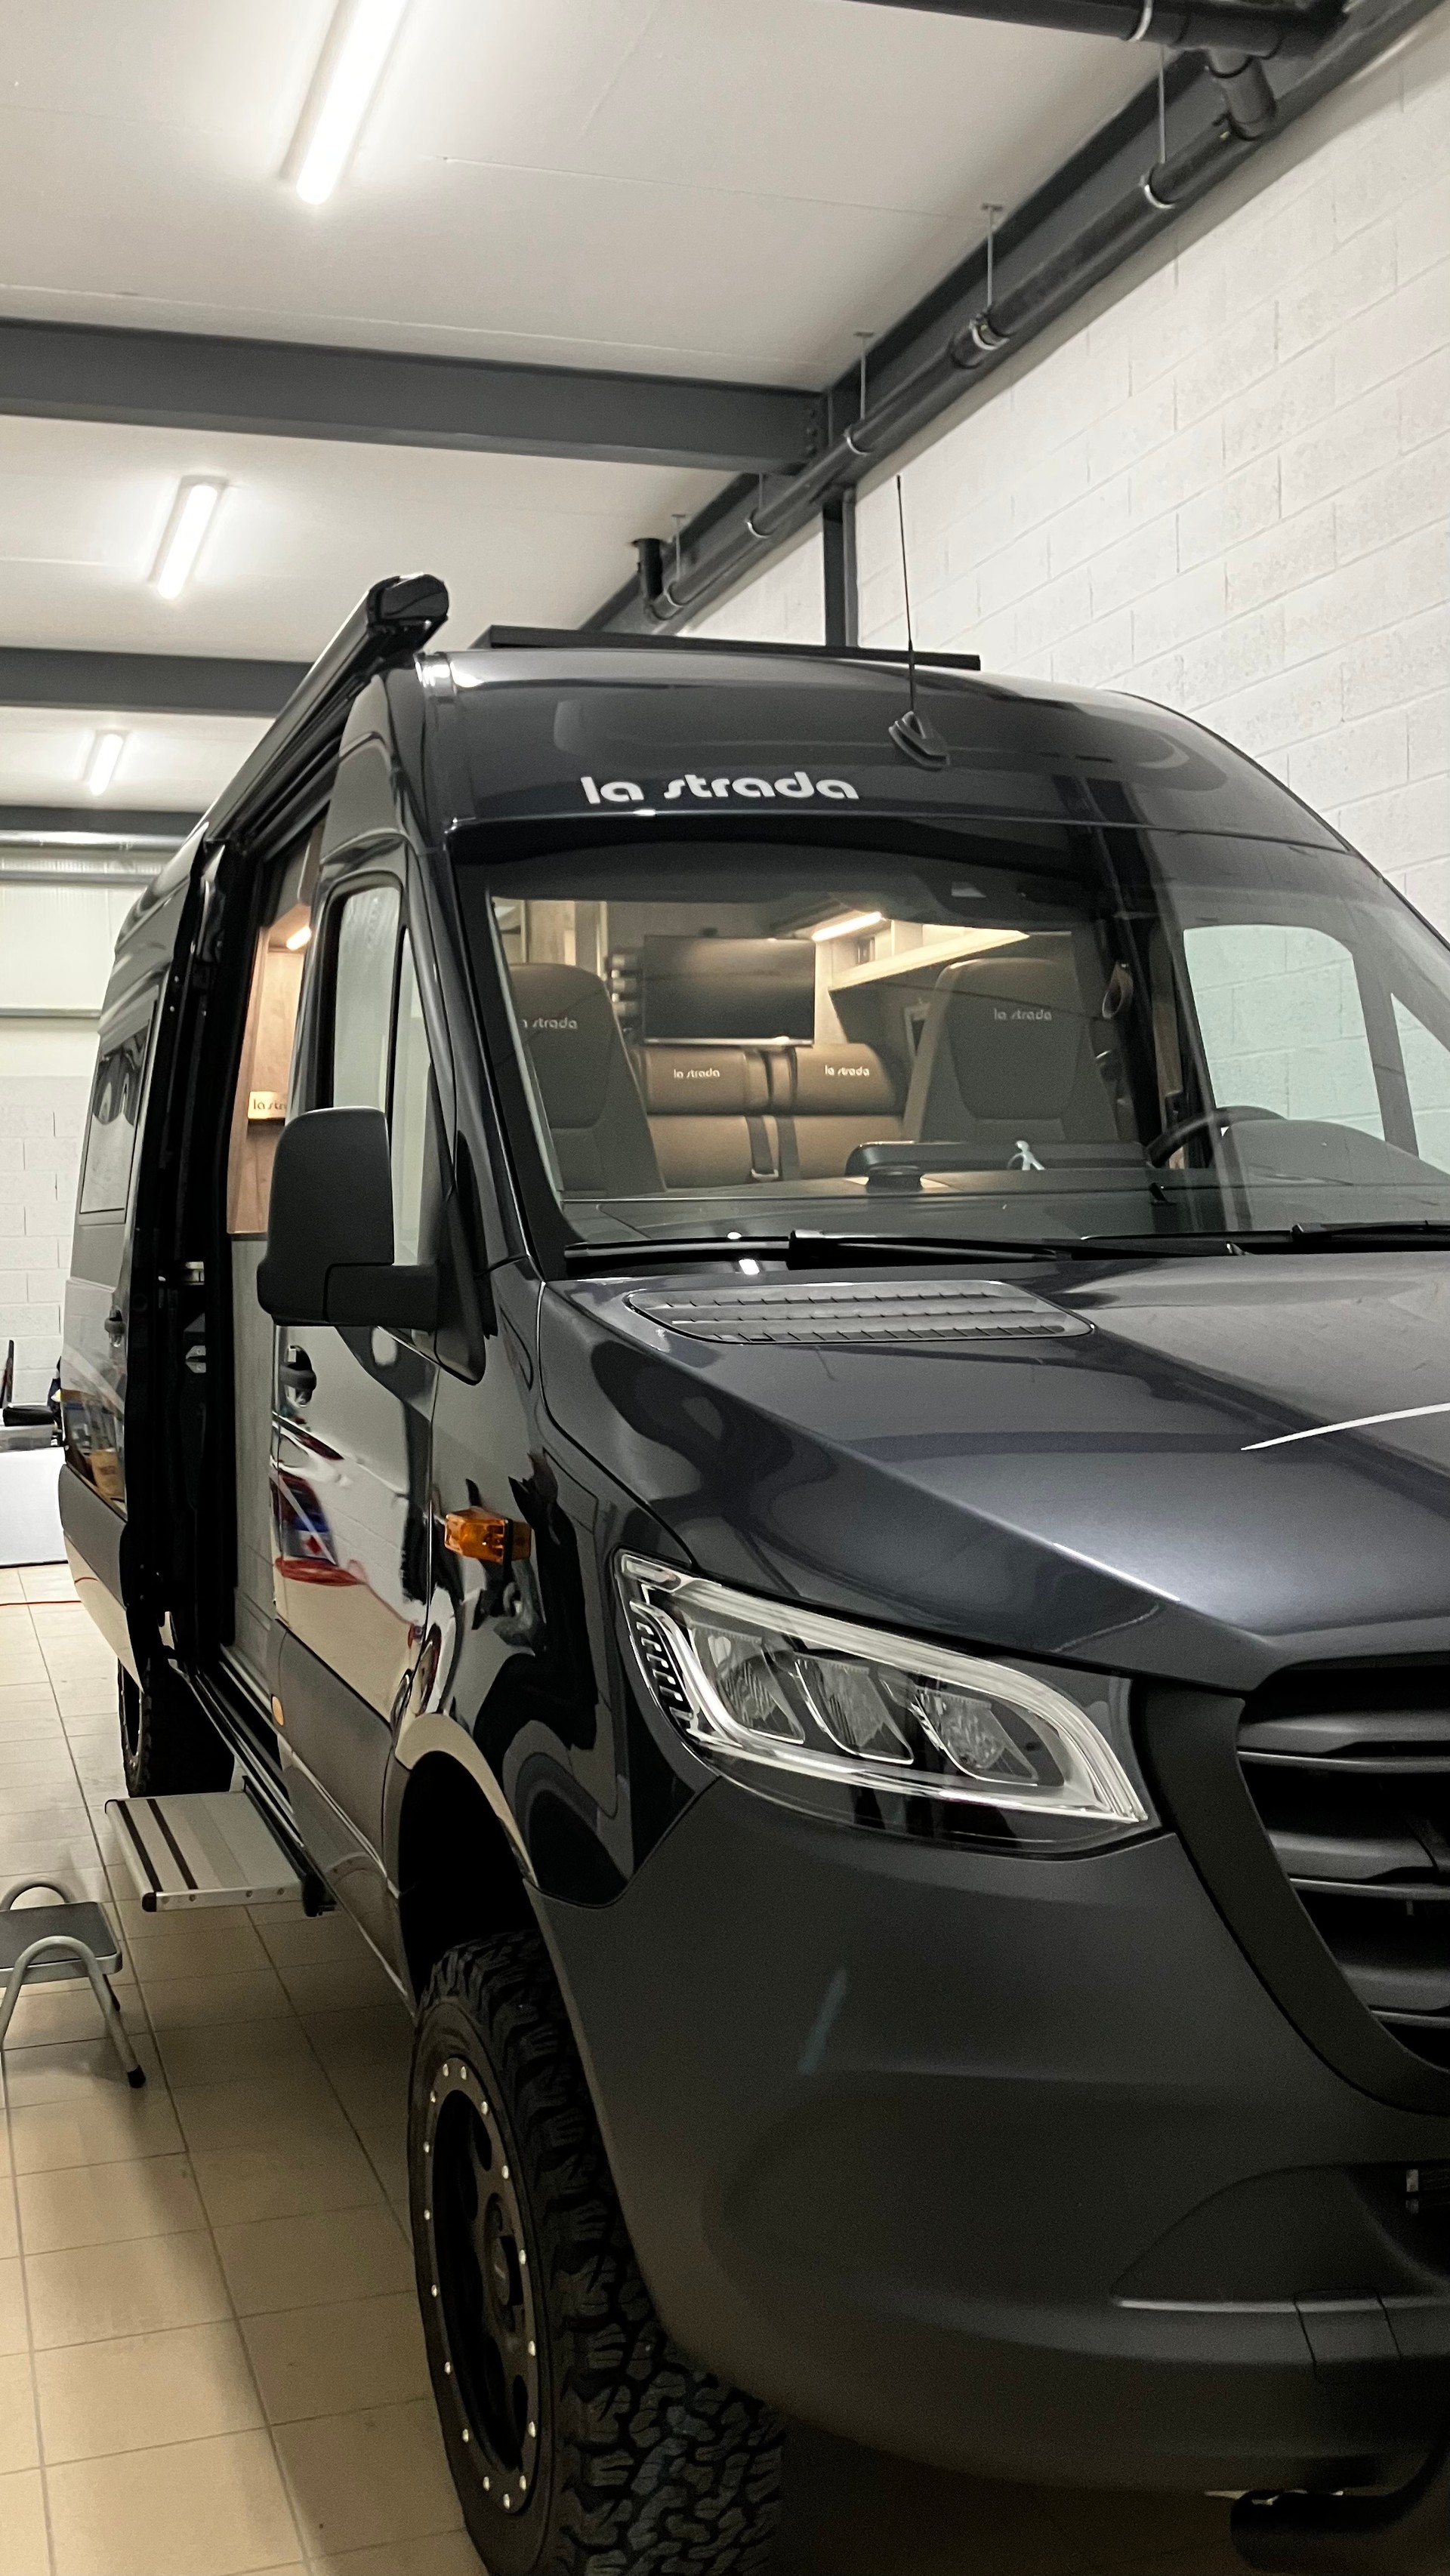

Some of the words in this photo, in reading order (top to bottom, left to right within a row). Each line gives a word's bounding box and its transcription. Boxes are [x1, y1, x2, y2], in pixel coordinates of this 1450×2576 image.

[580, 775, 644, 804] la
[663, 771, 859, 800] strada
[994, 1008, 1007, 1020] la
[1012, 1009, 1052, 1021] strada
[532, 1017, 577, 1029] strada
[674, 1068, 683, 1079] la
[686, 1067, 720, 1079] strada
[825, 1065, 835, 1076] la
[253, 1098, 266, 1110] la
